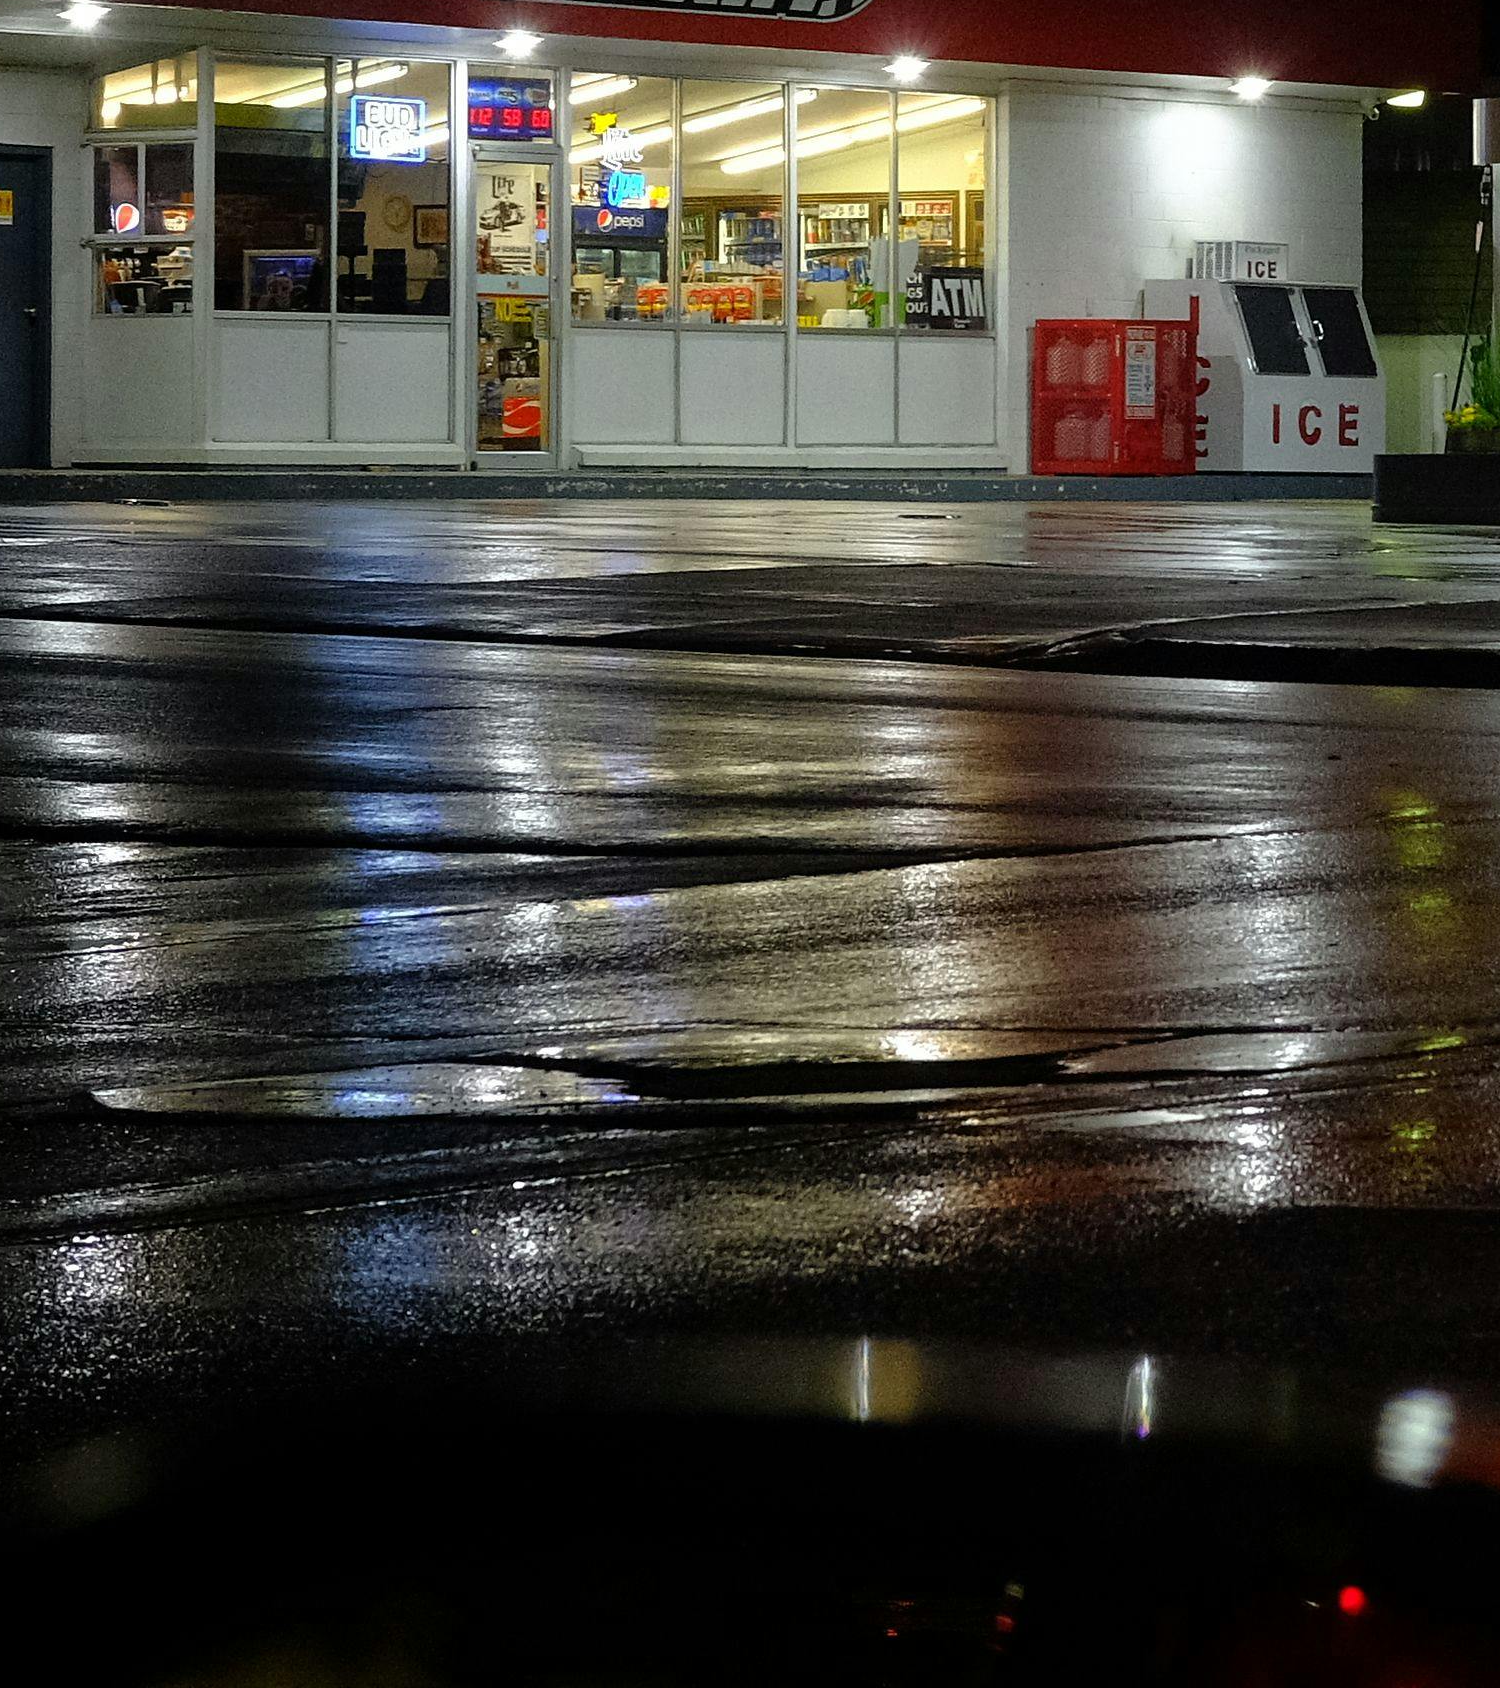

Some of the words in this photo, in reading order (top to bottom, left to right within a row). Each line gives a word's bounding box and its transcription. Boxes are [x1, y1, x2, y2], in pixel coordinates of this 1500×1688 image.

[613, 214, 644, 230] pepsi
[1247, 260, 1277, 278] ICE
[931, 277, 985, 317] ATM
[1272, 403, 1359, 446] ICE
